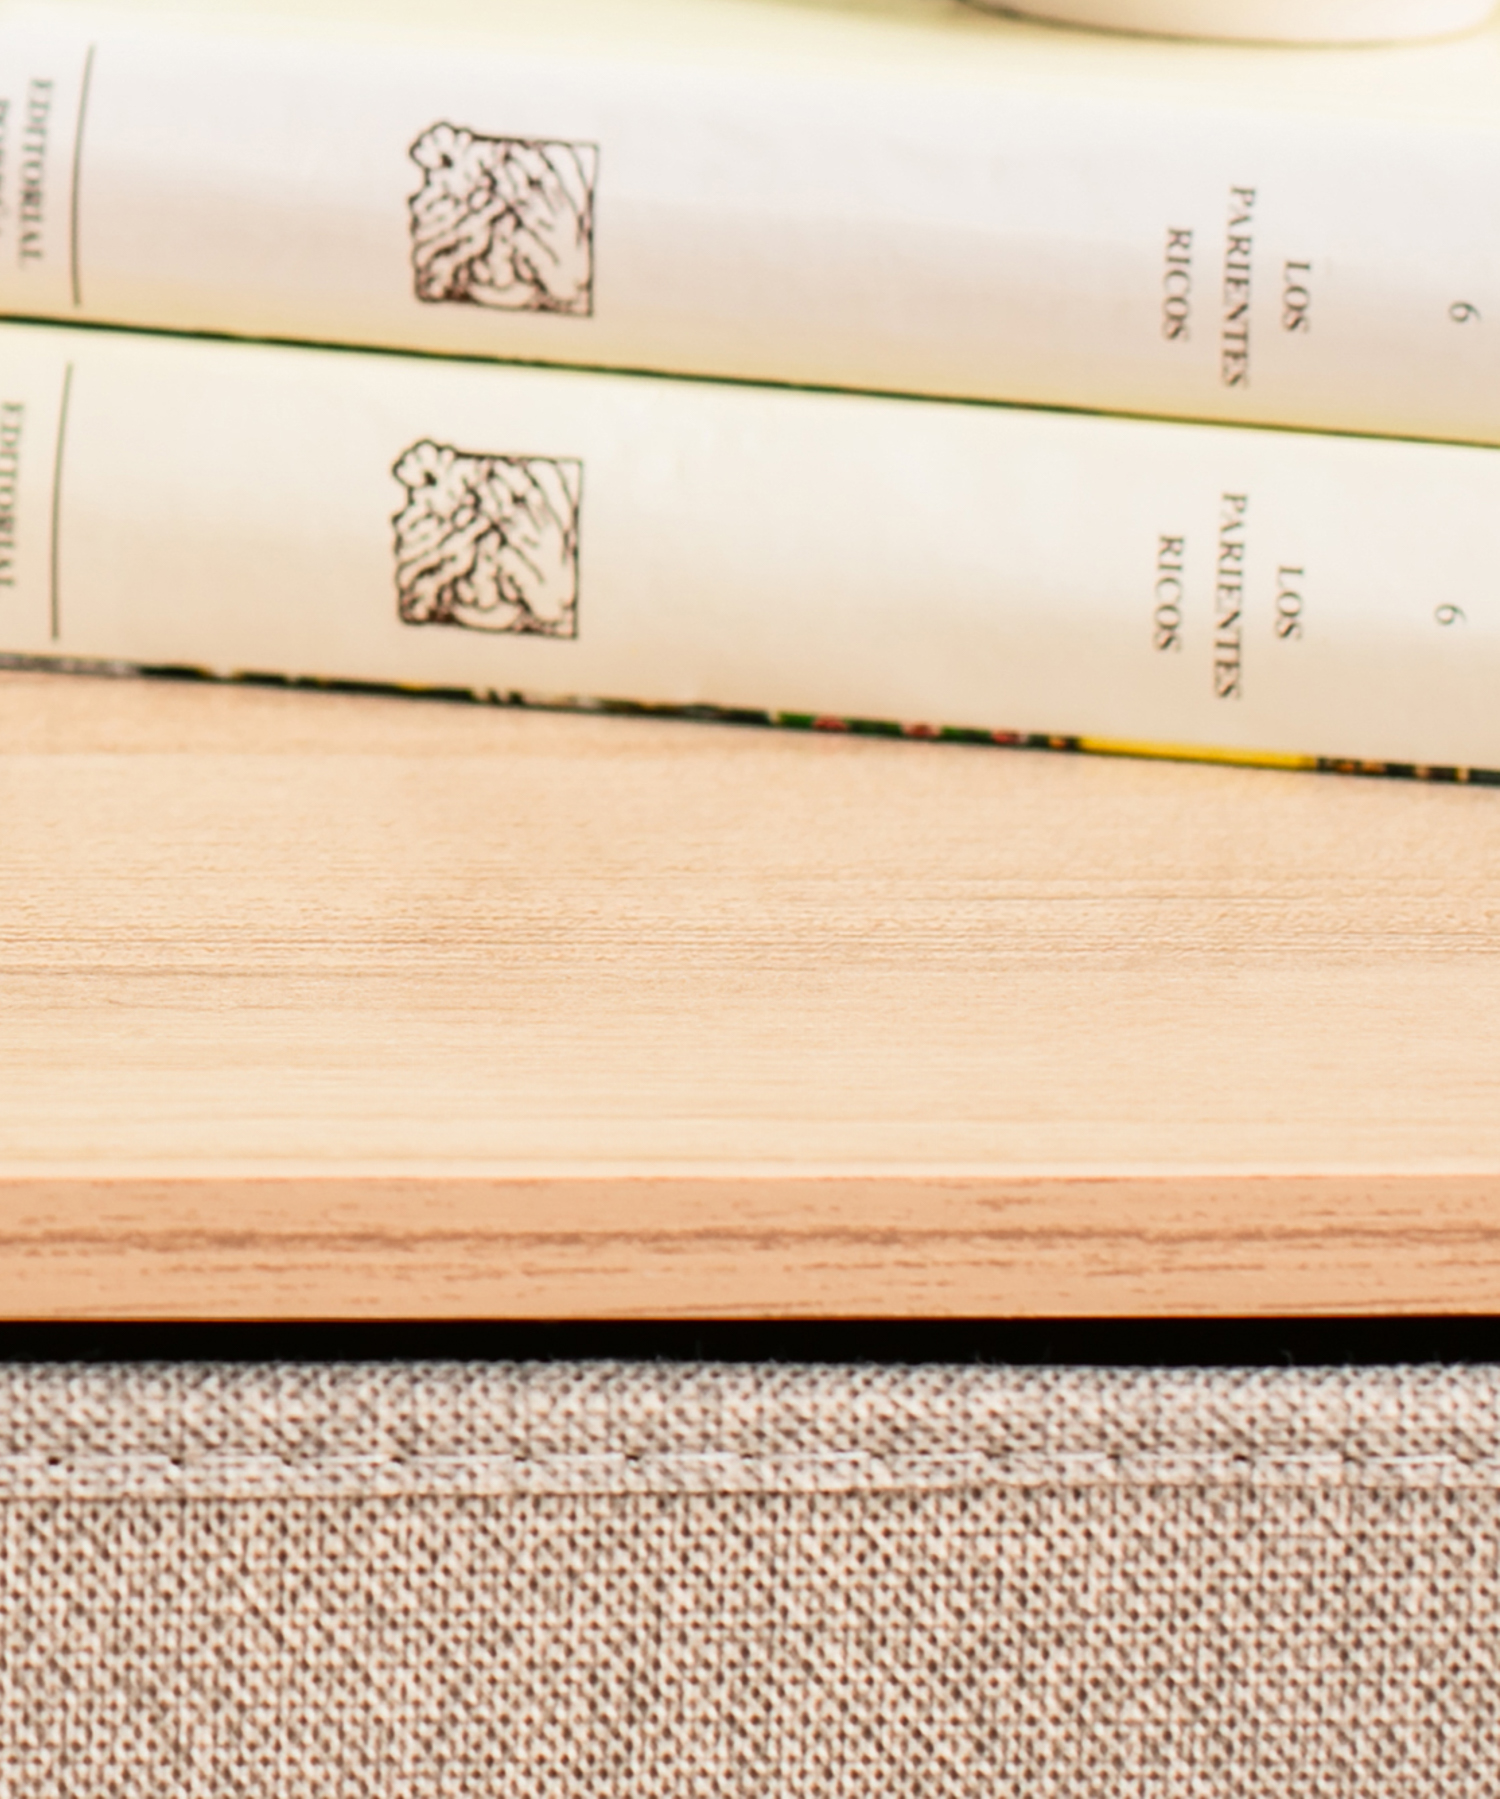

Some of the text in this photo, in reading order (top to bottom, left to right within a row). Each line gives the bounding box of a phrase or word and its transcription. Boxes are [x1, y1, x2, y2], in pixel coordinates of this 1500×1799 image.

[15, 78, 55, 269] EDITORIAL
[1163, 227, 1194, 342] RICOS
[1222, 185, 1257, 388] PARIENTES
[1282, 260, 1312, 333] LOS
[1448, 301, 1481, 325] 6
[1154, 535, 1186, 652] RICOS
[1214, 492, 1249, 700] PARIENTES
[1275, 565, 1305, 640] LOS
[1435, 603, 1466, 627] 6
